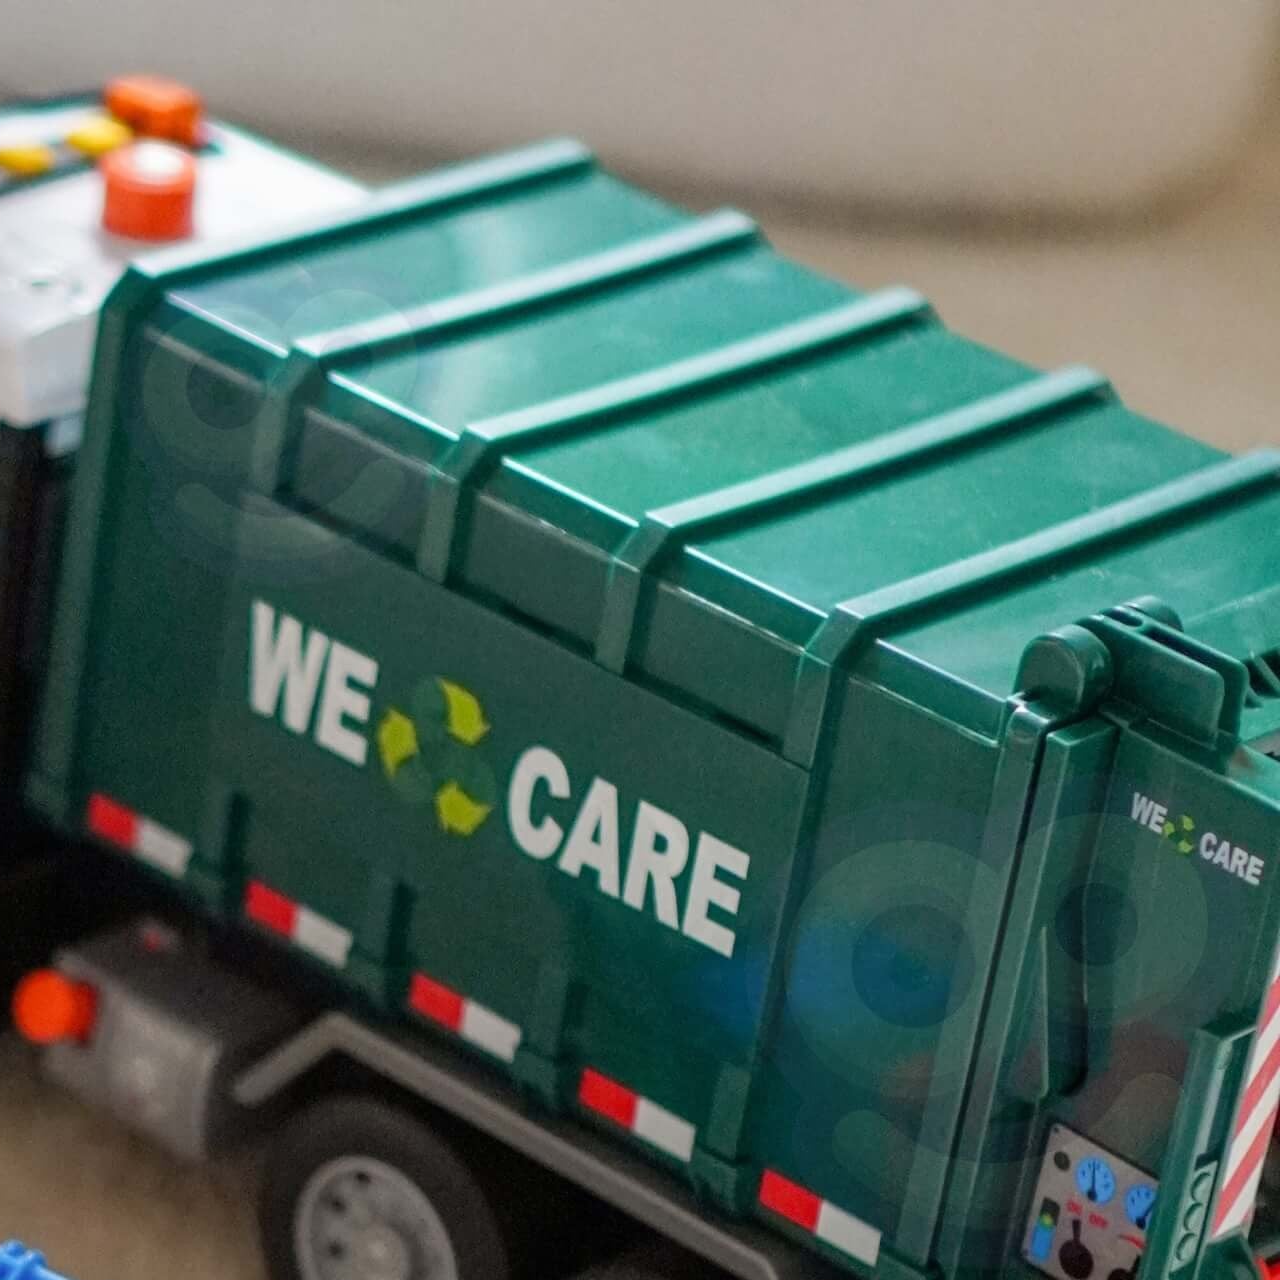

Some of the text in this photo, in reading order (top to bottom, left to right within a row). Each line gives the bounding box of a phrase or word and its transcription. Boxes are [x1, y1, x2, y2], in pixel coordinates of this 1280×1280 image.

[250, 599, 750, 958] WE CARE
[1131, 792, 1265, 885] WE CARE
